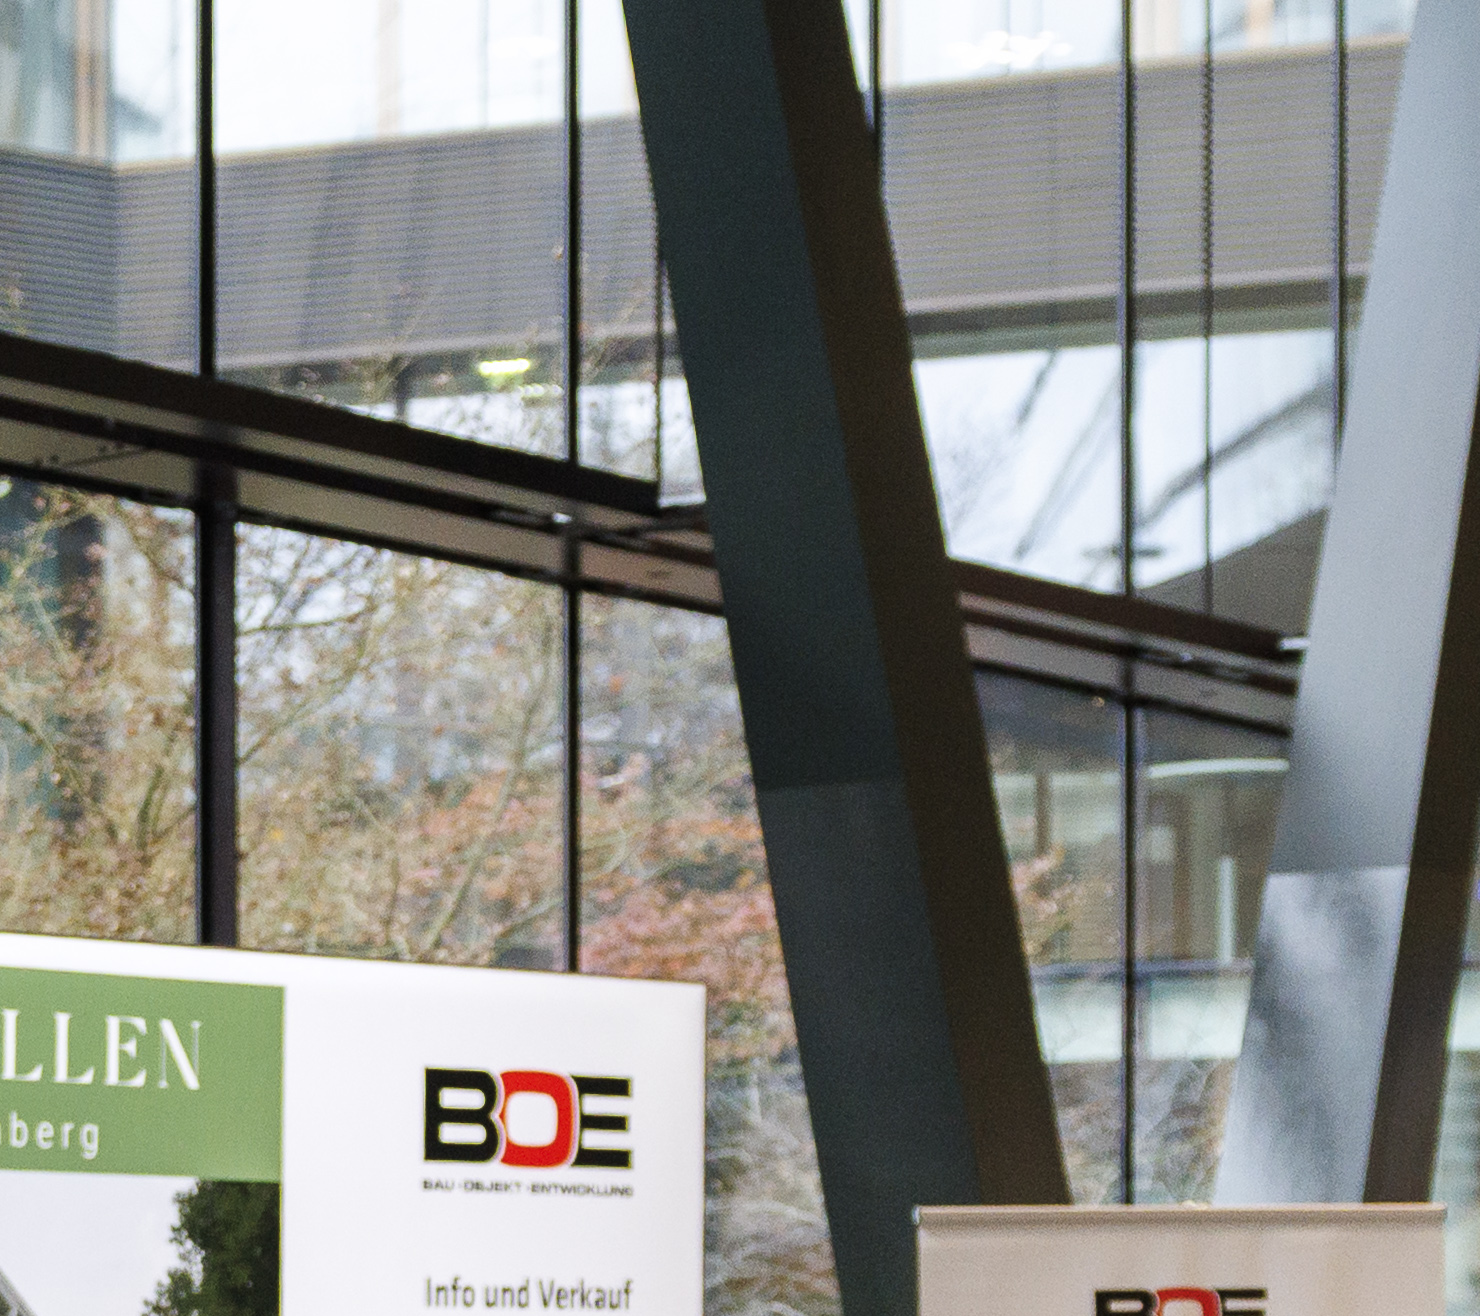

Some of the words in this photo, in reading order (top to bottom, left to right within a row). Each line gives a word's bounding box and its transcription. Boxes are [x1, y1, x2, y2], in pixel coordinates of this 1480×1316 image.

[423, 1067, 632, 1169] BOE
[425, 1276, 475, 1309] Info
[484, 1277, 529, 1309] und
[538, 1278, 633, 1310] Verkauf
